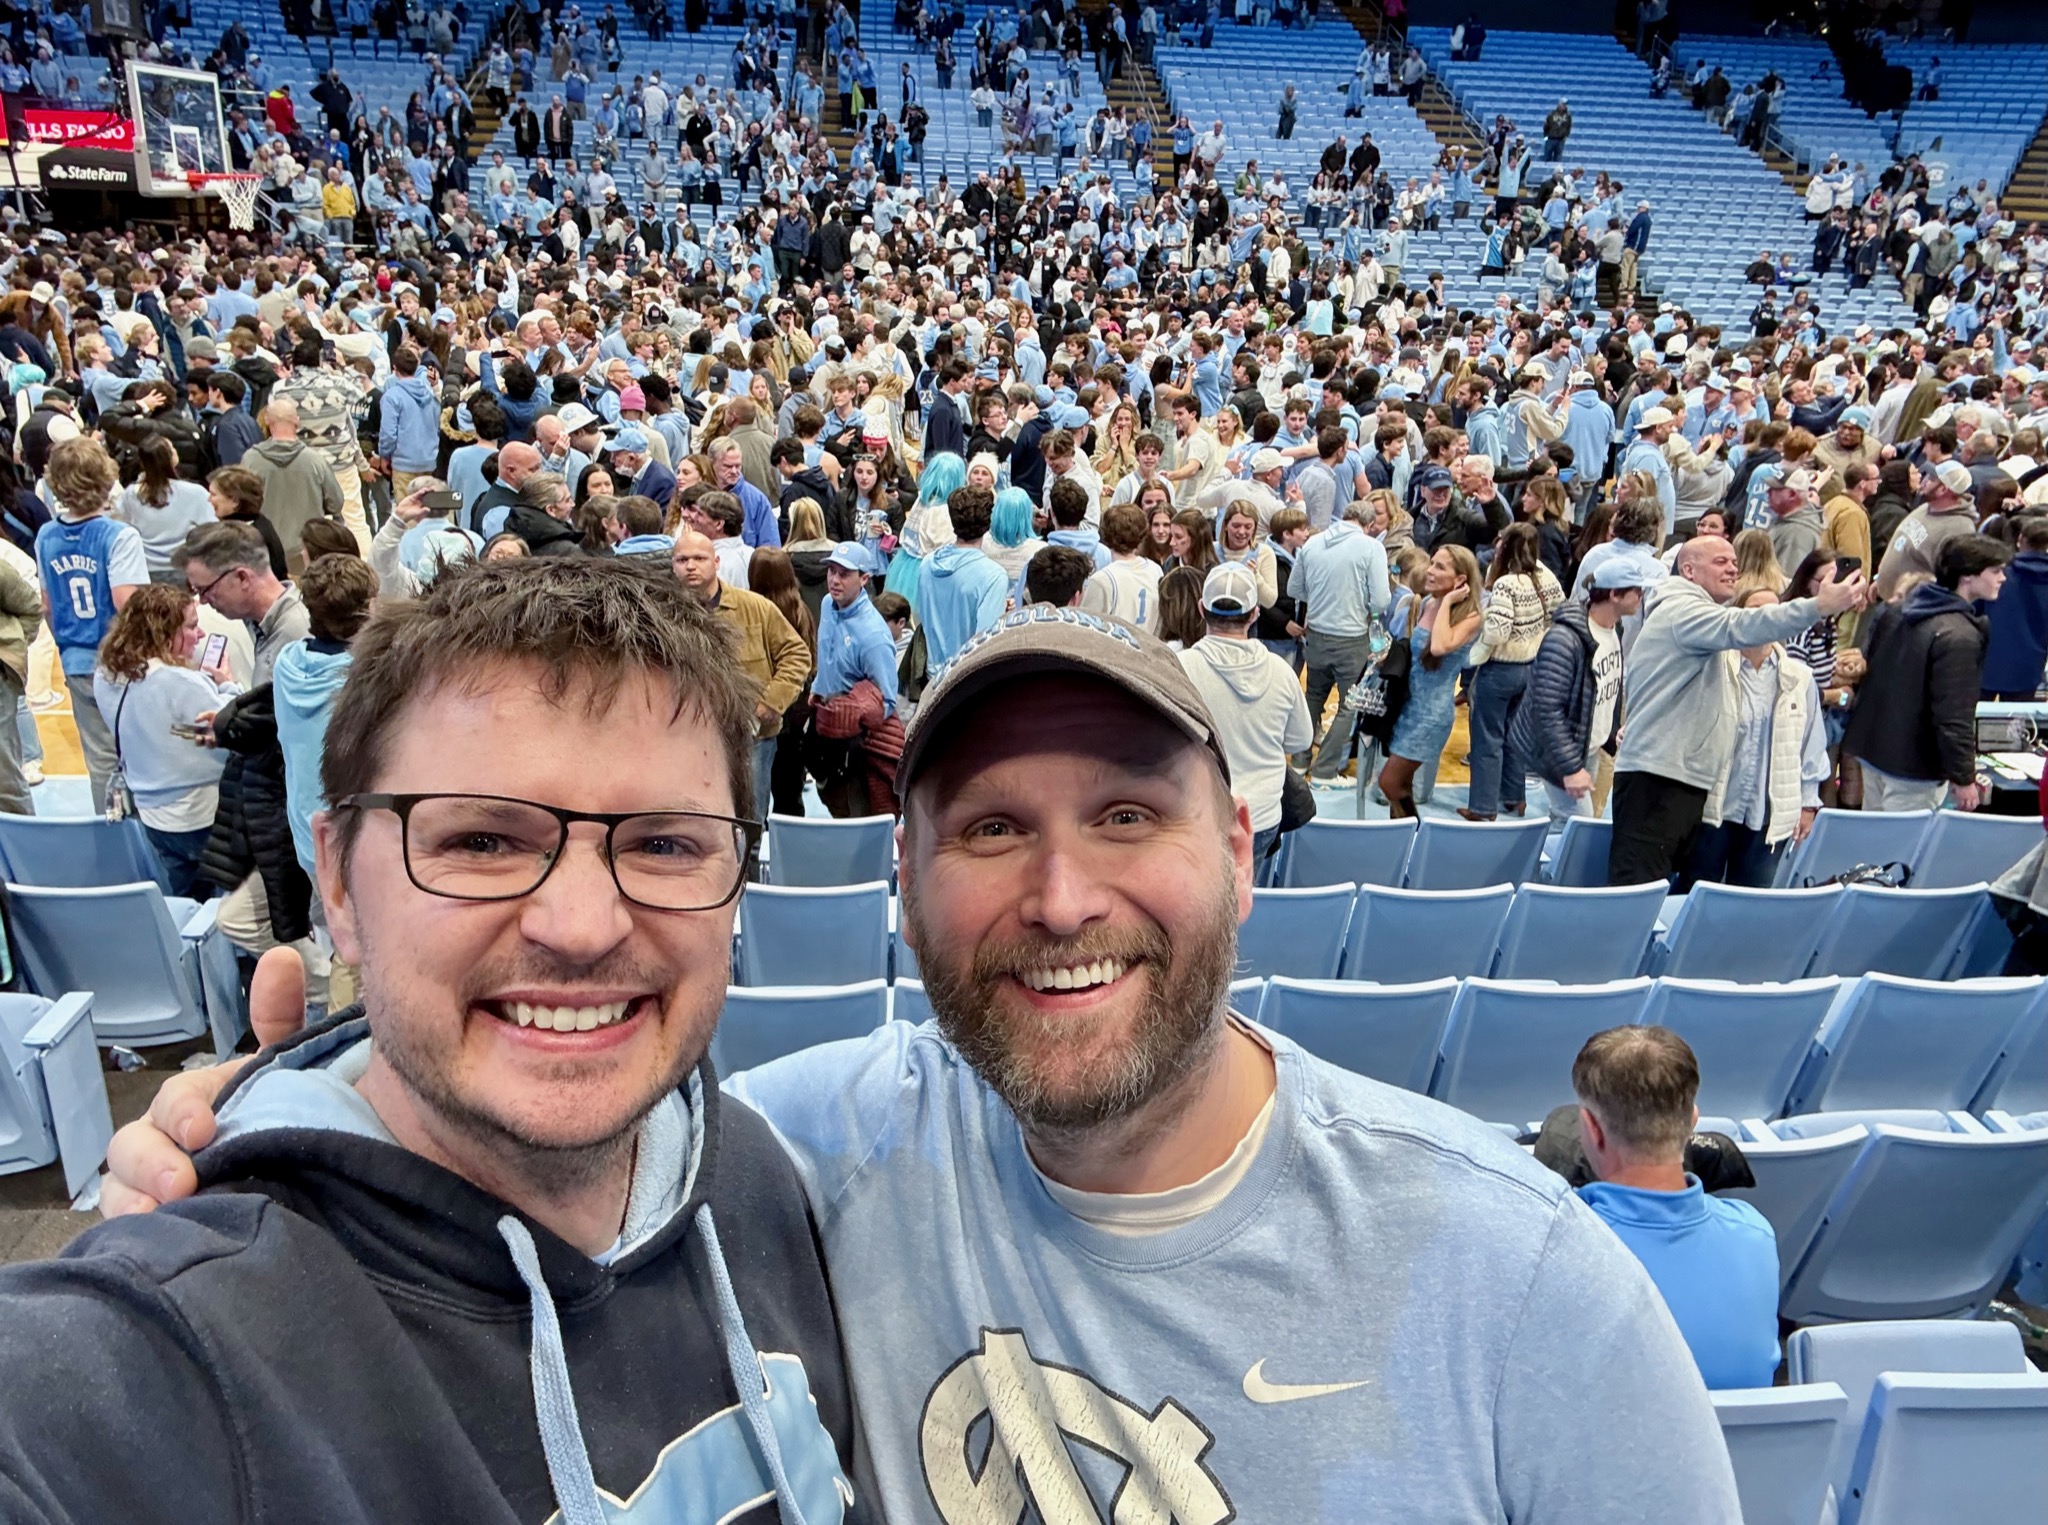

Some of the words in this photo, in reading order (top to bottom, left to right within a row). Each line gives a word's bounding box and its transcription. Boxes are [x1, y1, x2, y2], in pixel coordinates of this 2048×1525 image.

[28, 123, 62, 138] LLS
[920, 389, 934, 404] 23
[1745, 498, 1771, 529] 15
[50, 554, 98, 575] HARRIS
[69, 577, 96, 619] 0
[1593, 650, 1620, 680] NORT
